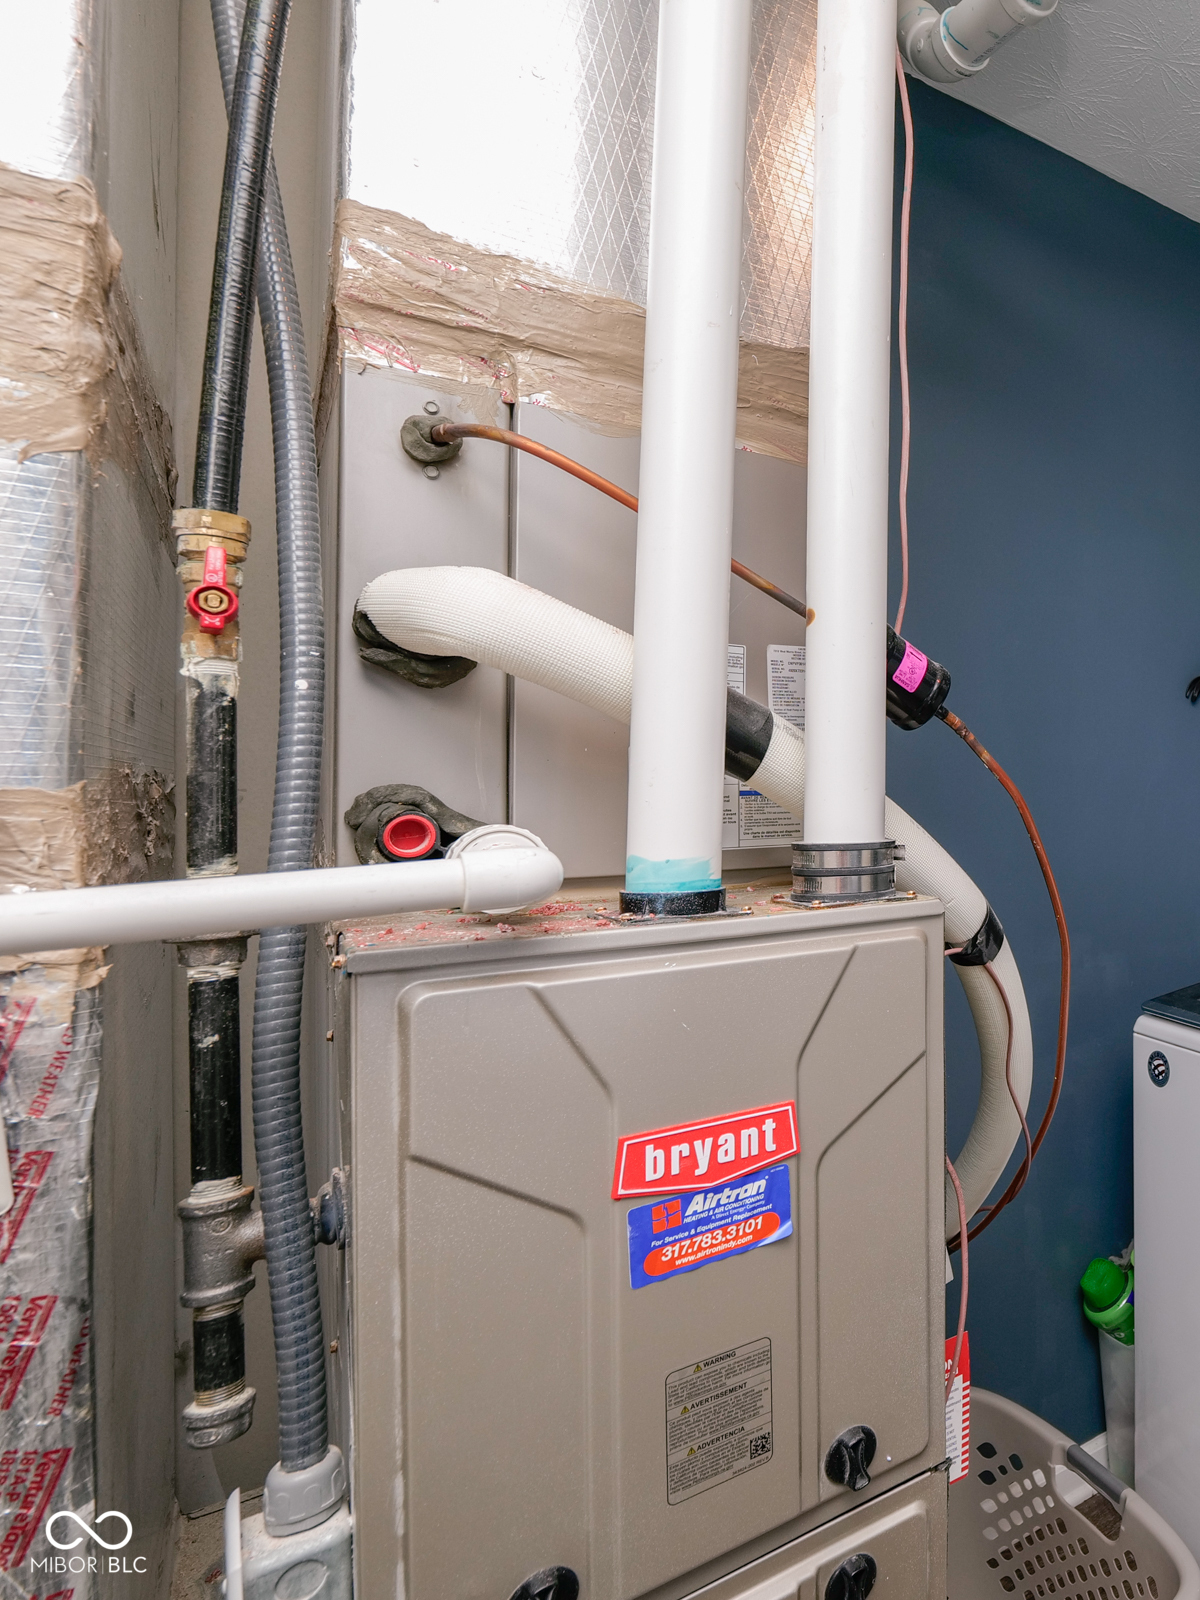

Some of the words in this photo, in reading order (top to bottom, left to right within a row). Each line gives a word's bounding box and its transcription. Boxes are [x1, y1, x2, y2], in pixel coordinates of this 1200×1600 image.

[27, 1050, 71, 1118] WEATHER
[645, 1118, 776, 1182] bryant
[683, 1211, 708, 1224] HEATING
[724, 1193, 764, 1211] CONDITIONING
[684, 1179, 767, 1217] Airtron
[716, 1211, 729, 1219] Direct
[651, 1236, 664, 1248] For
[664, 1230, 689, 1243] Service
[697, 1217, 732, 1234] Equipment
[733, 1203, 773, 1222] Replacement
[661, 1216, 763, 1262] 317.783.3101
[675, 1235, 753, 1266] www.airtronindy.com
[703, 1351, 736, 1368] WARNING
[46, 1342, 87, 1417] WEATHER
[690, 1382, 748, 1410] AVERTISSEMENT
[697, 1426, 745, 1451] ADVERTENCIA
[6, 1449, 39, 1503] 181A-P
